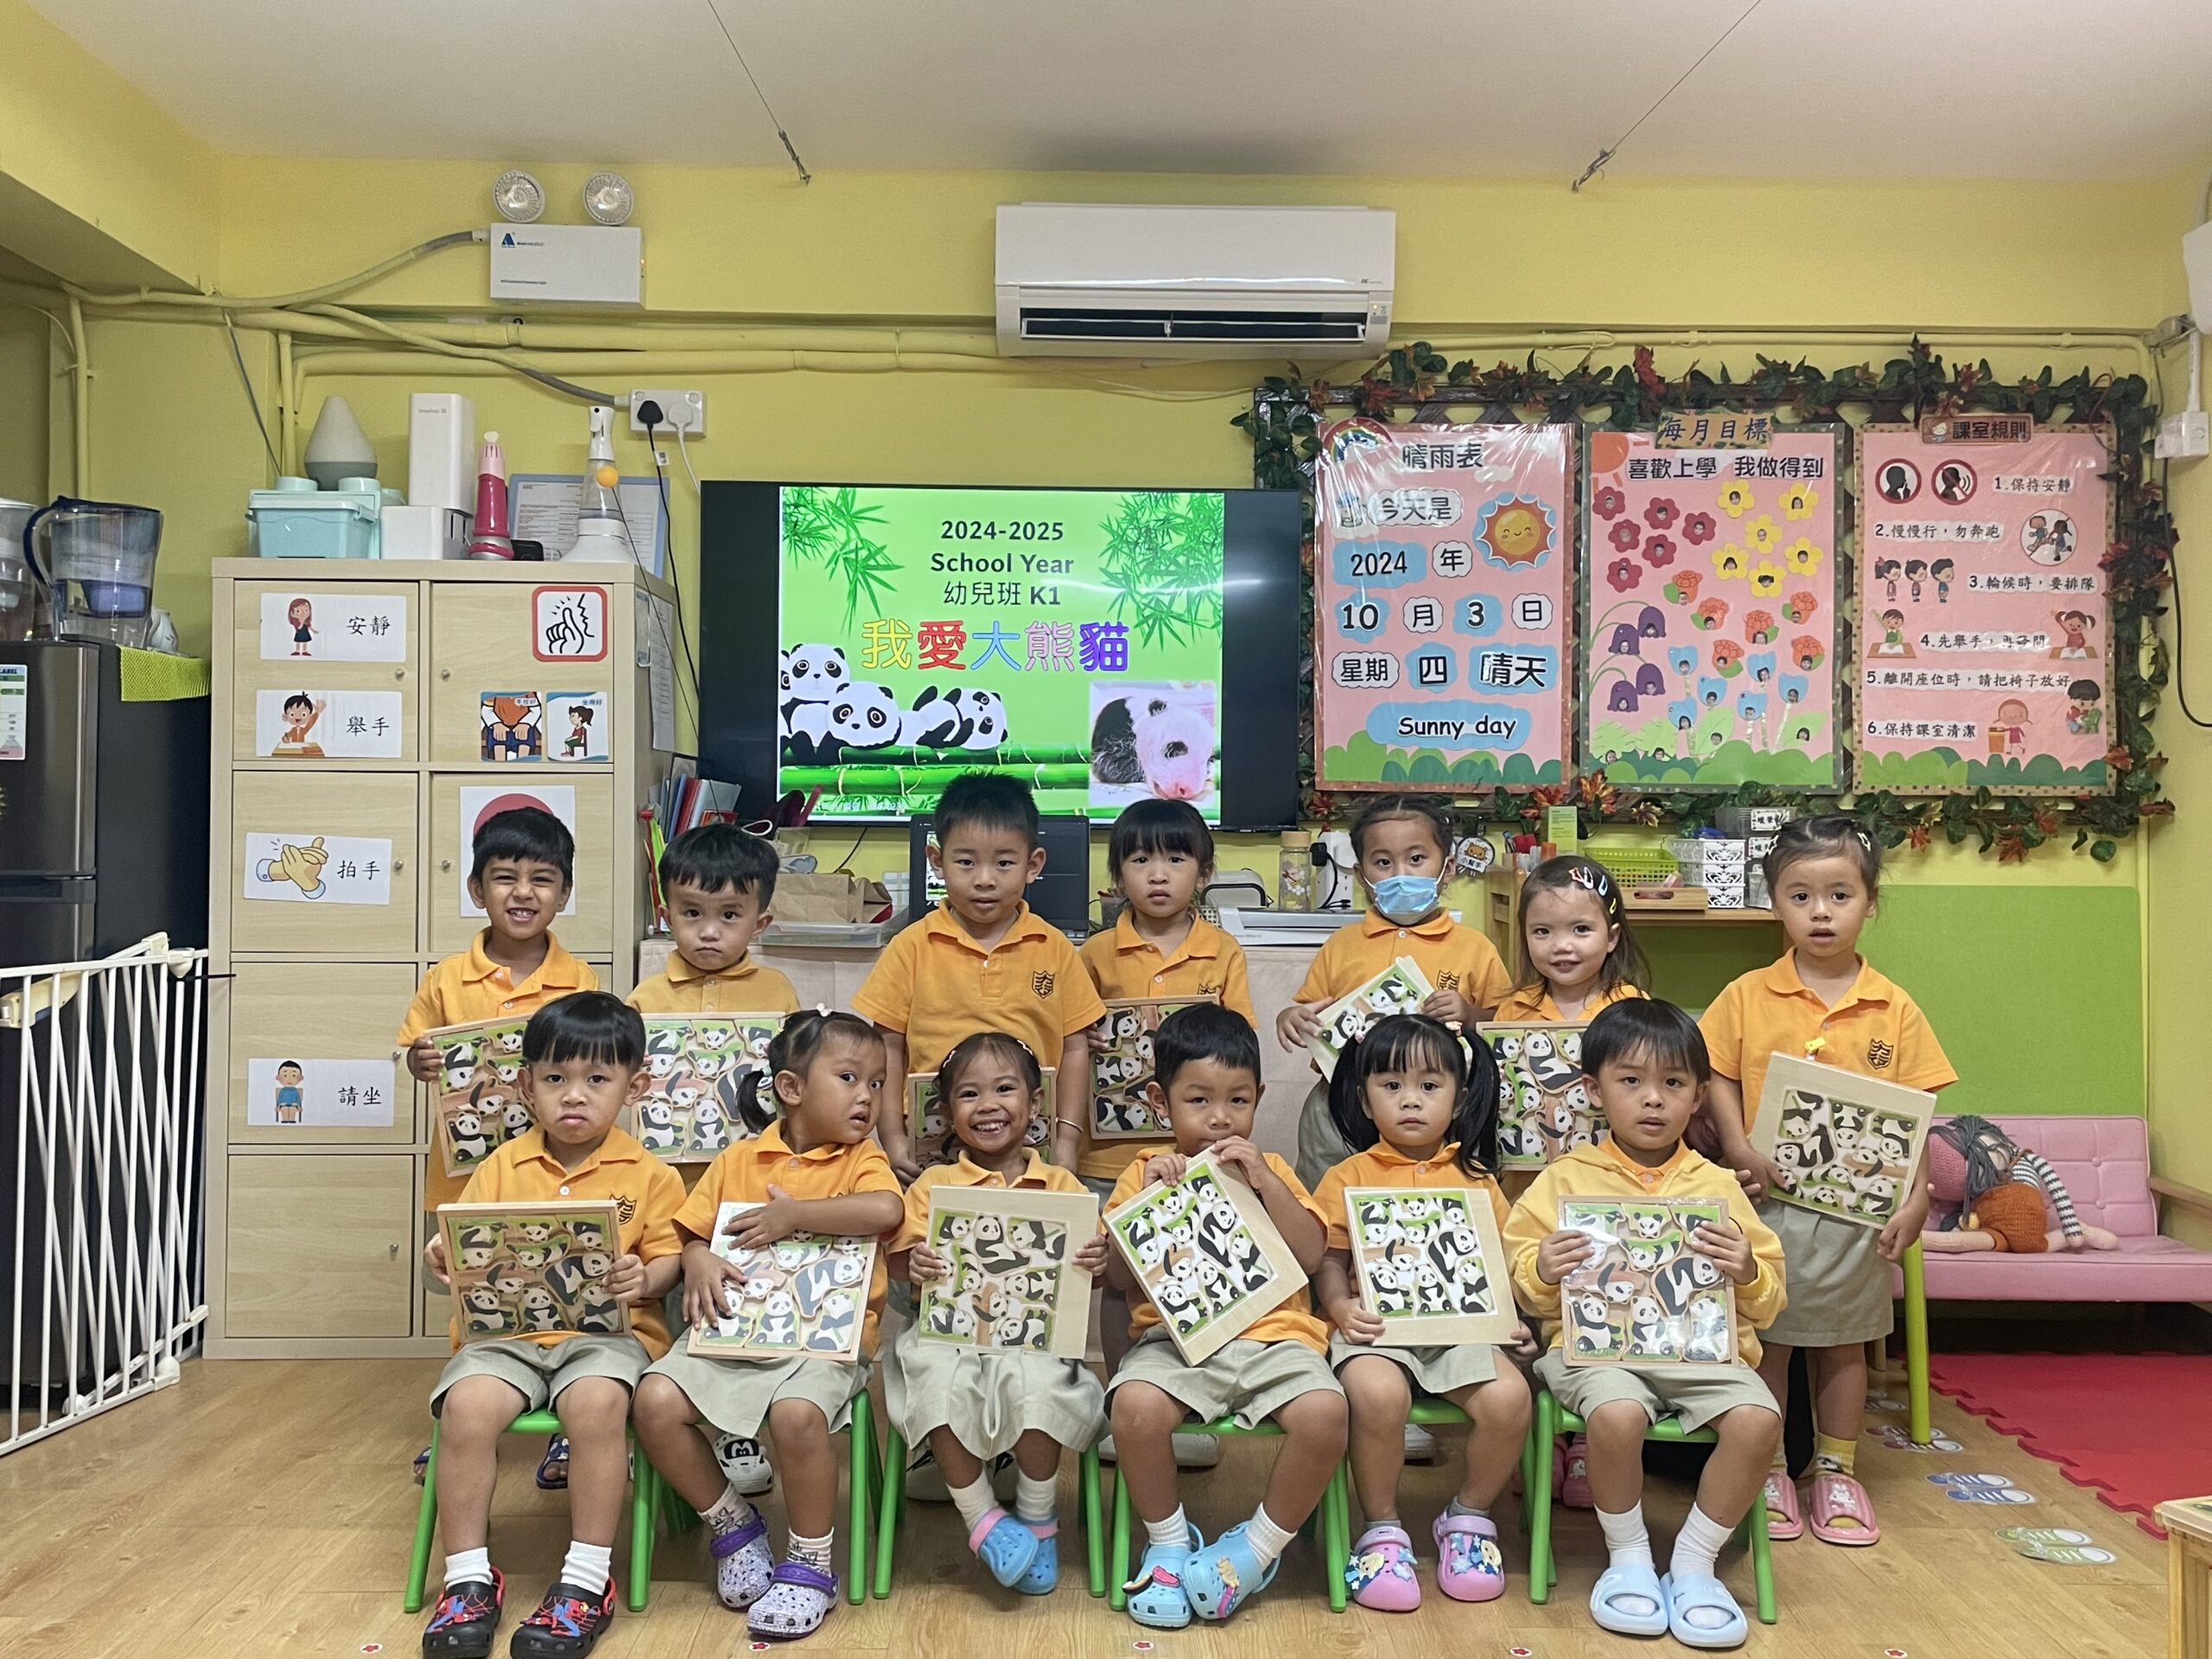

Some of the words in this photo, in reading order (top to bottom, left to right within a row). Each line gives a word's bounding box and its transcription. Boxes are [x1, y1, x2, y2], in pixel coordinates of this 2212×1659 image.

[1662, 417, 1769, 442] 每月目標
[1952, 422, 2027, 441] 課室規則
[1402, 442, 1484, 469] 晴雨表
[1628, 458, 1717, 479] 喜歡上學
[1734, 456, 1824, 479] 我做得到
[1382, 497, 1452, 521] 今天是
[940, 520, 1064, 541] 2024-2025
[930, 552, 1013, 573] School
[1020, 553, 1074, 574] Year
[1351, 550, 1408, 577] 2024
[1440, 548, 1465, 572] 年
[944, 581, 1022, 606] 幼兒班
[1029, 586, 1061, 606] K1
[346, 615, 392, 636] 安靜
[1342, 603, 1379, 630] 10
[1412, 604, 1434, 628] 月
[1467, 601, 1485, 627] 3
[1522, 600, 1542, 622] 日
[861, 618, 1130, 672] 我愛大熊貓
[1340, 658, 1389, 683] 星期
[1418, 655, 1448, 685] 四
[1479, 652, 1548, 688] 晴天
[346, 715, 390, 737] 舉手
[1397, 716, 1465, 741] Sunny
[1475, 714, 1517, 740] day
[337, 860, 380, 880] 拍手
[338, 1086, 382, 1107] 請坐
